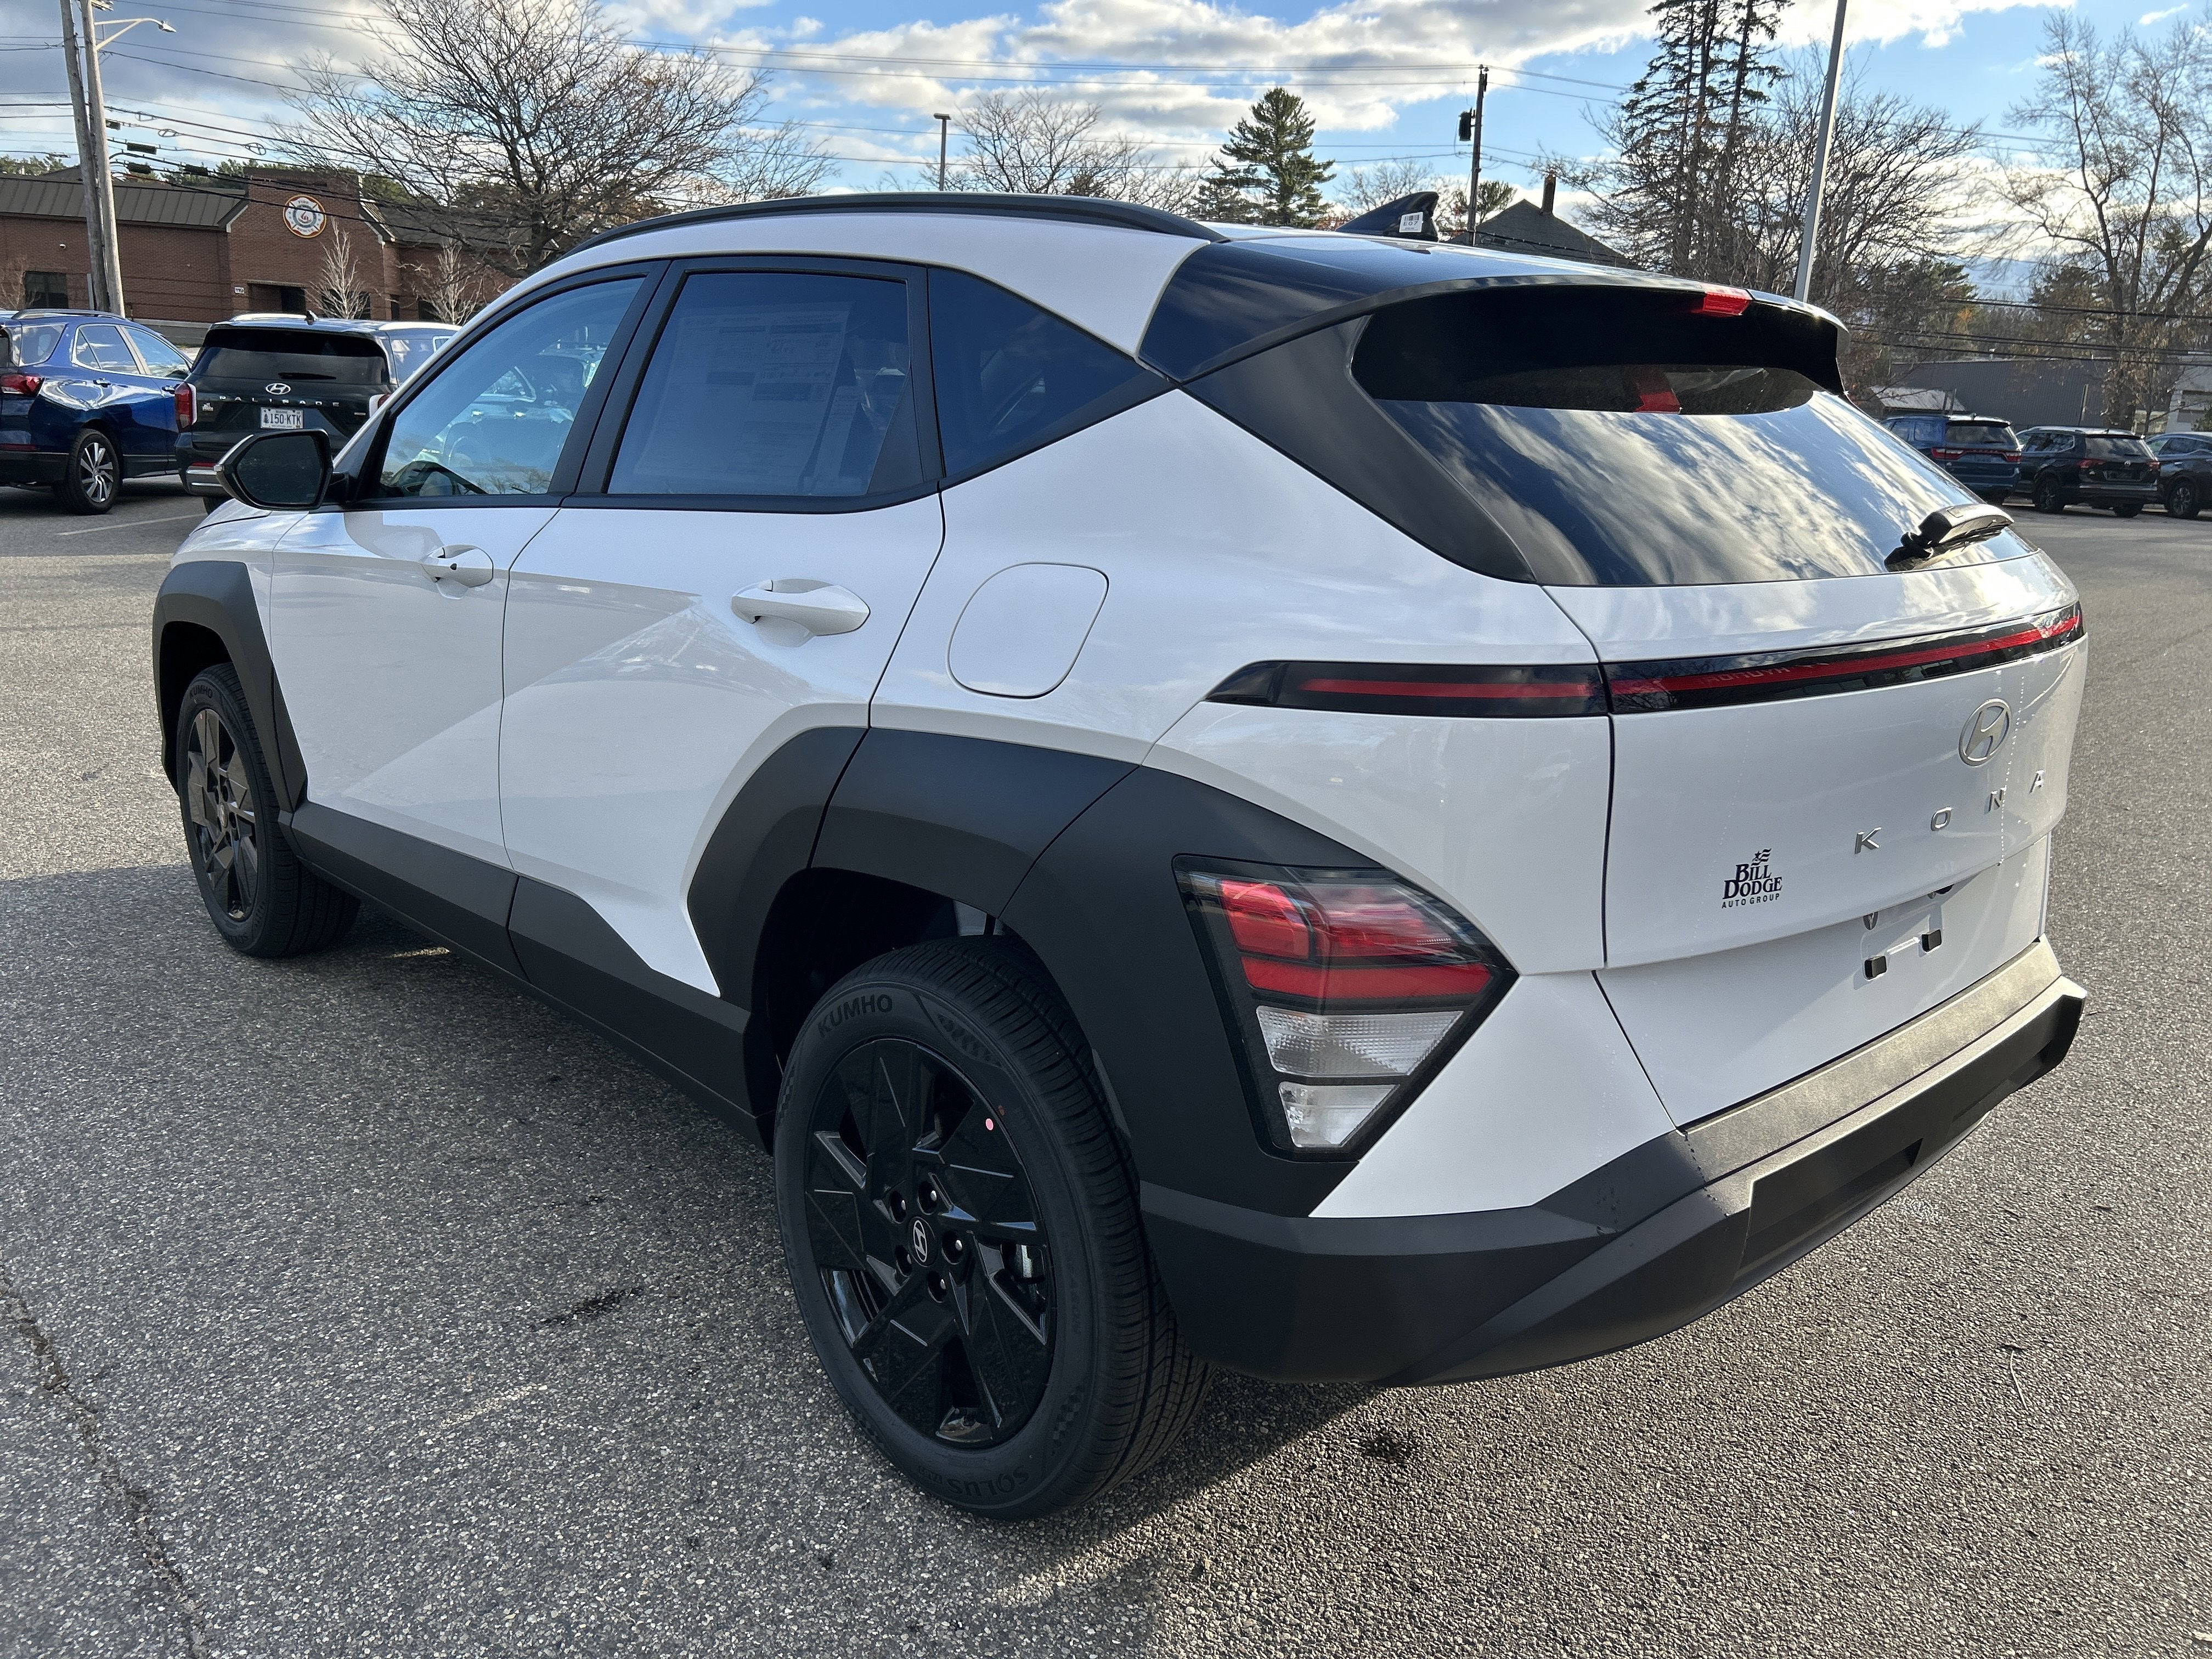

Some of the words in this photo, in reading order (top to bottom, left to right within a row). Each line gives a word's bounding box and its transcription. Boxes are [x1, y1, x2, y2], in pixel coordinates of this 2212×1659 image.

[270, 414, 284, 424] 150
[287, 415, 301, 425] KTK
[1854, 770, 2045, 854] KONA
[1736, 864, 1772, 883] BILL
[1722, 876, 1782, 900] DODGE
[1722, 899, 1746, 909] AUTO
[1750, 893, 1780, 905] GROUP
[817, 994, 893, 1038] KUMHO
[947, 1465, 1029, 1497] SOLUS
